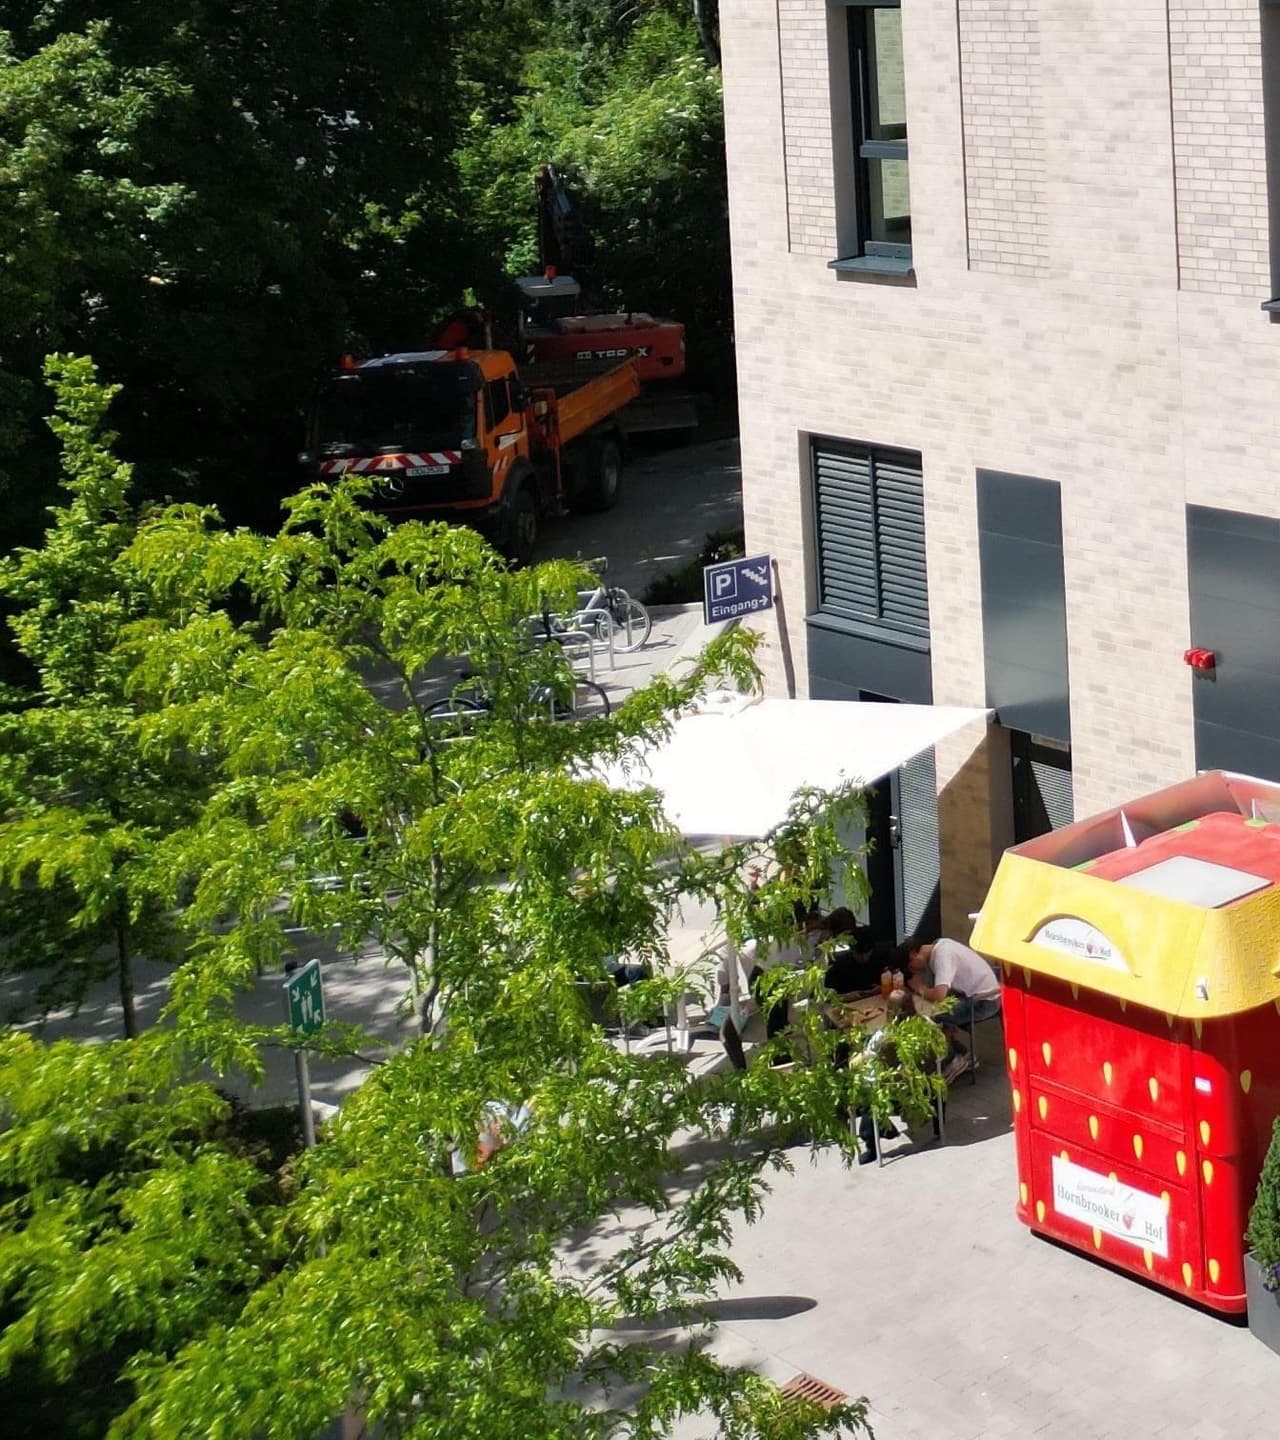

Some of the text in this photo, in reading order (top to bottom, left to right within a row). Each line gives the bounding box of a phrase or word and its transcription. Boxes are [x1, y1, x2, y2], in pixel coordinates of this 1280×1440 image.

[715, 574, 731, 596] P
[712, 598, 758, 617] Eingang
[1057, 1184, 1120, 1222] Hornbrooker
